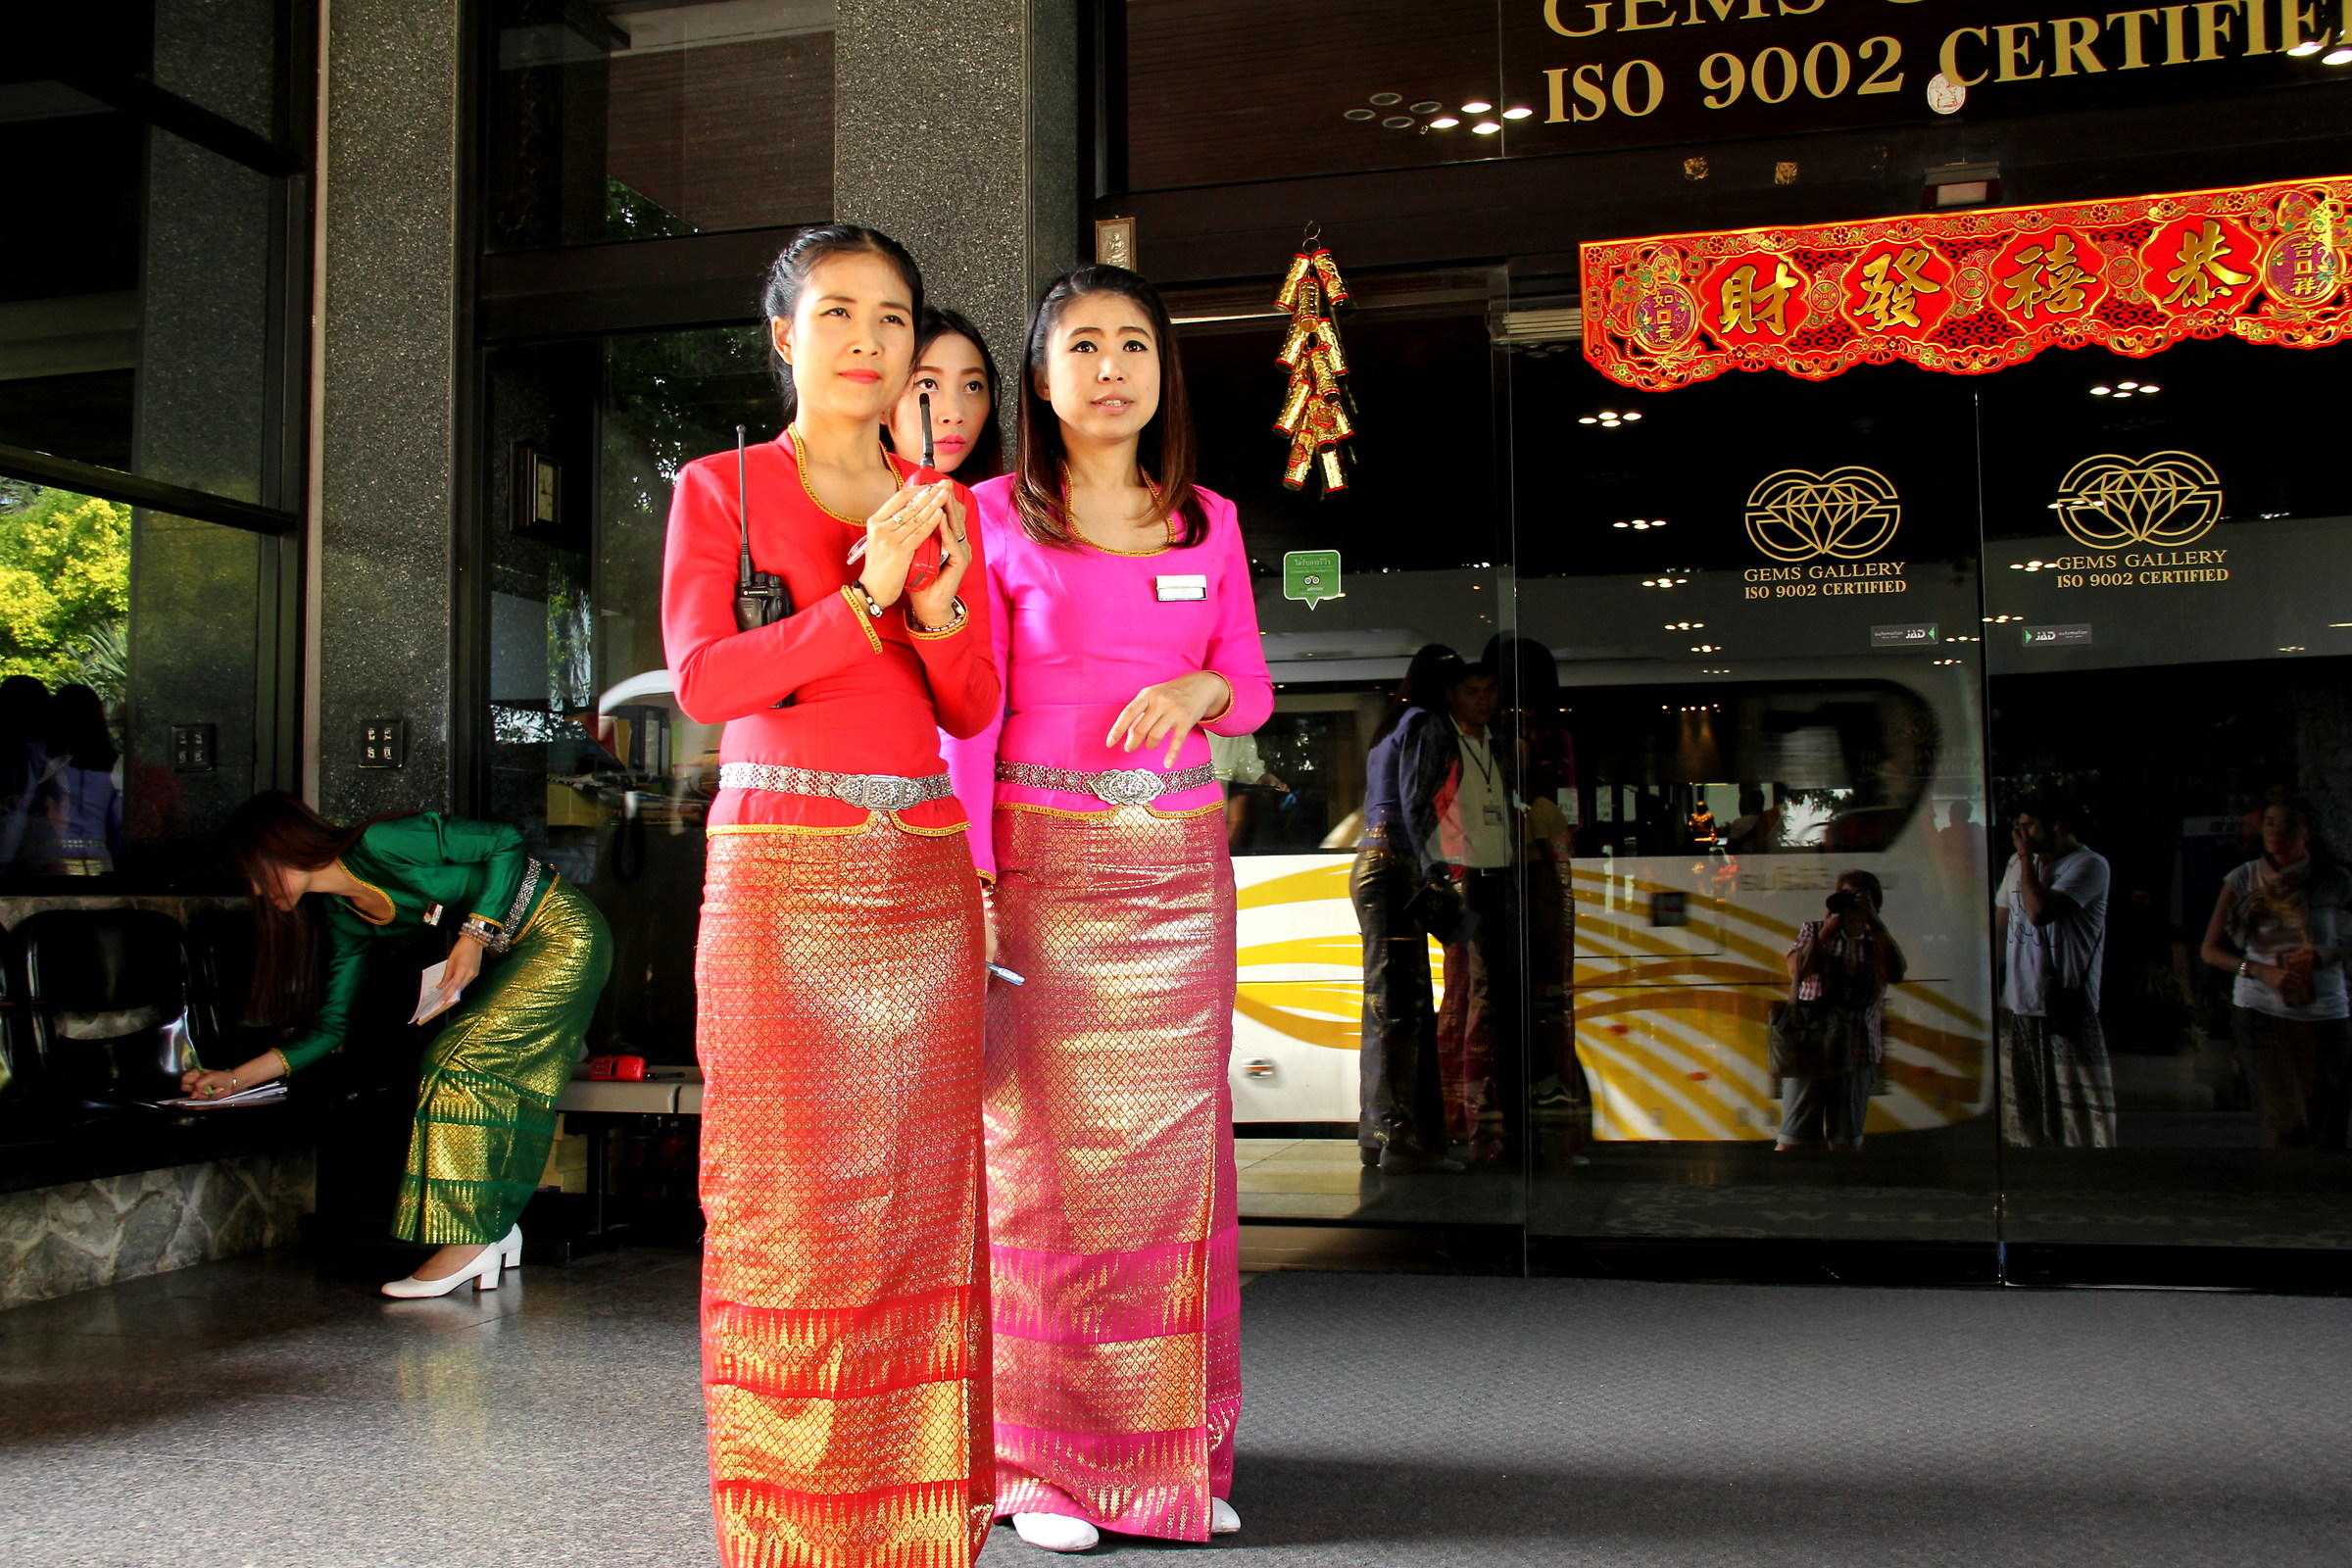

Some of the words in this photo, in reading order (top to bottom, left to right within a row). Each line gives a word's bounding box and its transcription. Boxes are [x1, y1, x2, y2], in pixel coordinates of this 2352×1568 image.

[1543, 60, 1664, 123] ISO
[1699, 36, 1904, 109] 9002
[1938, 0, 2352, 87] CERTIFIE
[2056, 555, 2117, 570] GEMS
[2125, 549, 2228, 567] GALLERY
[1743, 566, 1801, 582] GEMS
[1808, 562, 1904, 579] GALLERY
[2057, 574, 2084, 588] ISO
[2090, 572, 2133, 587] 9002
[2139, 568, 2230, 585] CERTIFIED
[1744, 586, 1770, 600] ISO
[1776, 584, 1817, 598] 9002
[1823, 580, 1907, 596] CERTIFIED
